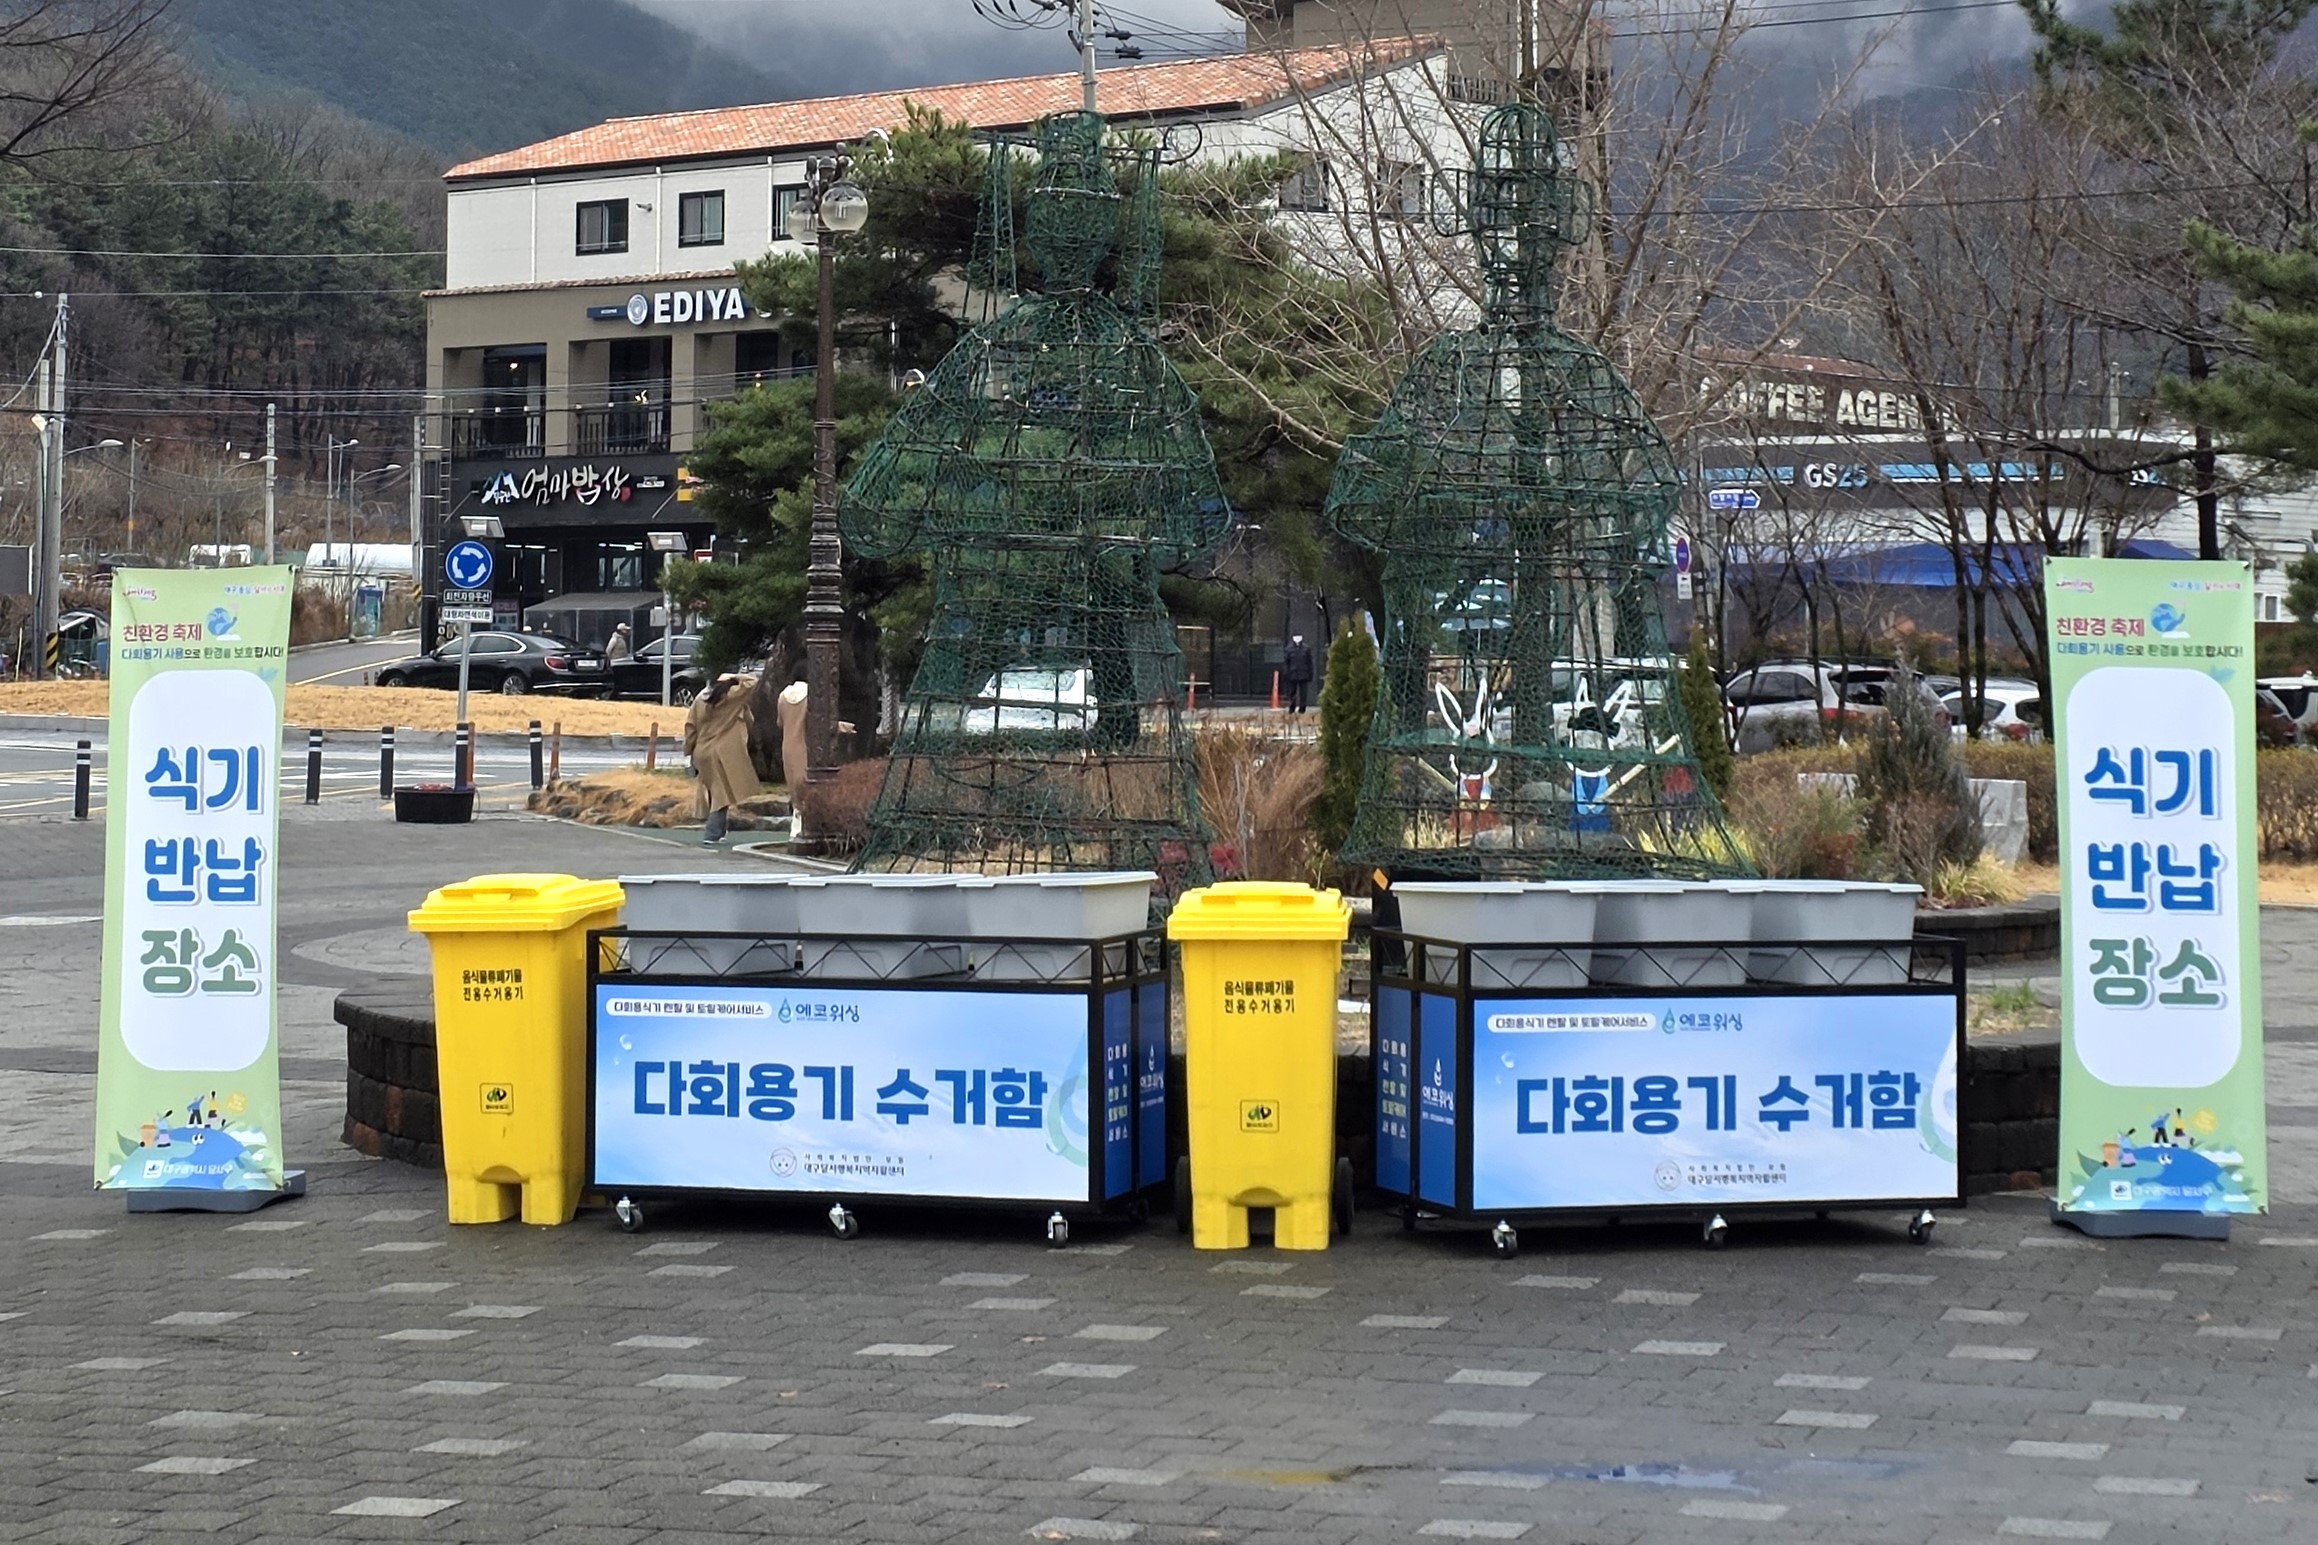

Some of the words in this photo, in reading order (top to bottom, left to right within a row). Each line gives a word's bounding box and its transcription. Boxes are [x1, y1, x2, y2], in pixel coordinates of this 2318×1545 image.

[653, 287, 745, 324] EDIYA
[521, 464, 631, 507] 엄마밥상
[1803, 462, 1869, 488] GS25
[122, 623, 169, 642] 친환경
[172, 622, 202, 642] 축제
[2056, 617, 2106, 637] 친환경
[2111, 617, 2145, 637] 축제
[121, 647, 163, 660] 다회용기
[164, 647, 200, 660] 사용으로
[234, 645, 284, 659] 보호합시다!
[2056, 642, 2101, 656] 다회용기
[2103, 643, 2144, 657] 사용으로
[2182, 645, 2243, 658] 보호합시다!
[145, 745, 260, 811] 식기
[2084, 747, 2216, 816] 식기
[145, 837, 262, 902] 반납
[2088, 842, 2221, 911] 반납
[140, 928, 258, 994] 장소
[462, 968, 523, 984] 음식물류폐기물
[2089, 937, 2220, 1006] 장소
[1224, 980, 1294, 996] 음식물류폐기물
[634, 1060, 854, 1122] 다회용기
[876, 1067, 1048, 1128] 수거함
[1516, 1074, 1737, 1135] 다회용기
[1758, 1069, 1922, 1132] 수거함
